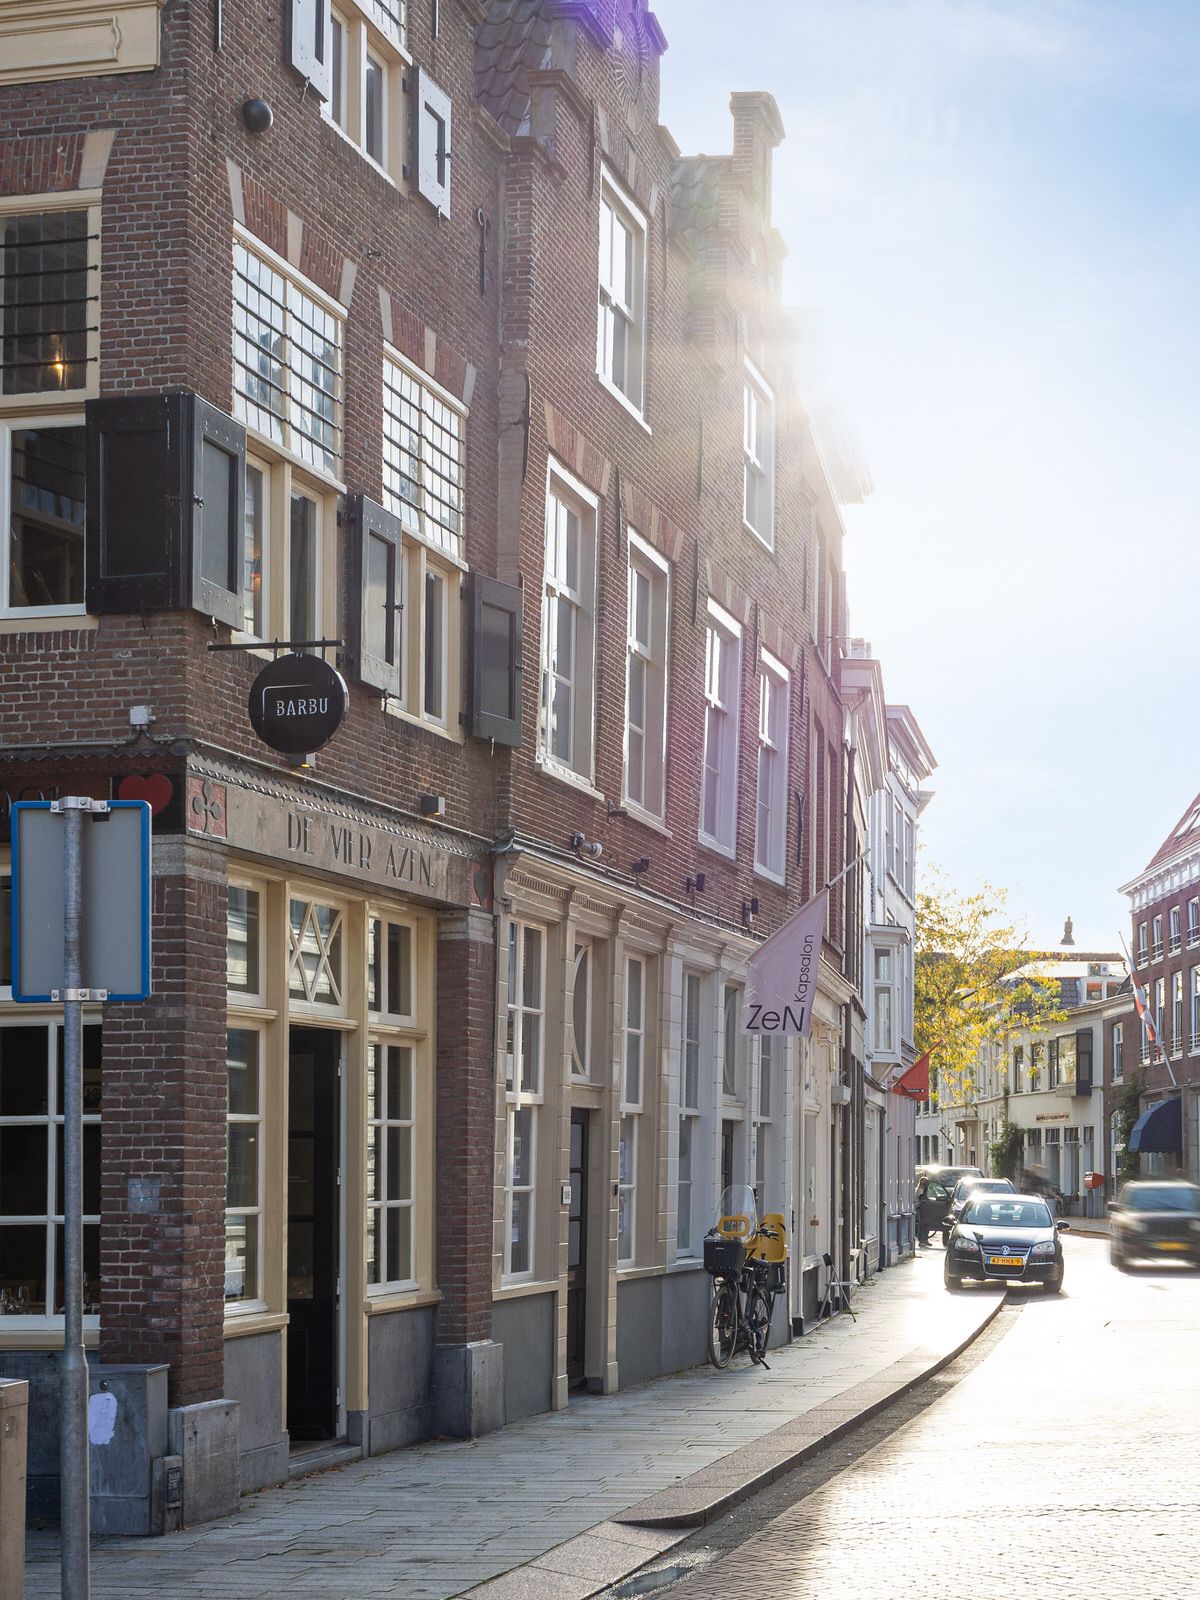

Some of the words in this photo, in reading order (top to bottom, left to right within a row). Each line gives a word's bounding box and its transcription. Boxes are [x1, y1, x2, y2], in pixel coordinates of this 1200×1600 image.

[276, 697, 328, 717] BARBU
[287, 811, 313, 856] DE
[330, 824, 372, 871] VIER
[794, 934, 815, 1003] Kapsalon
[746, 1004, 805, 1032] ZeN
